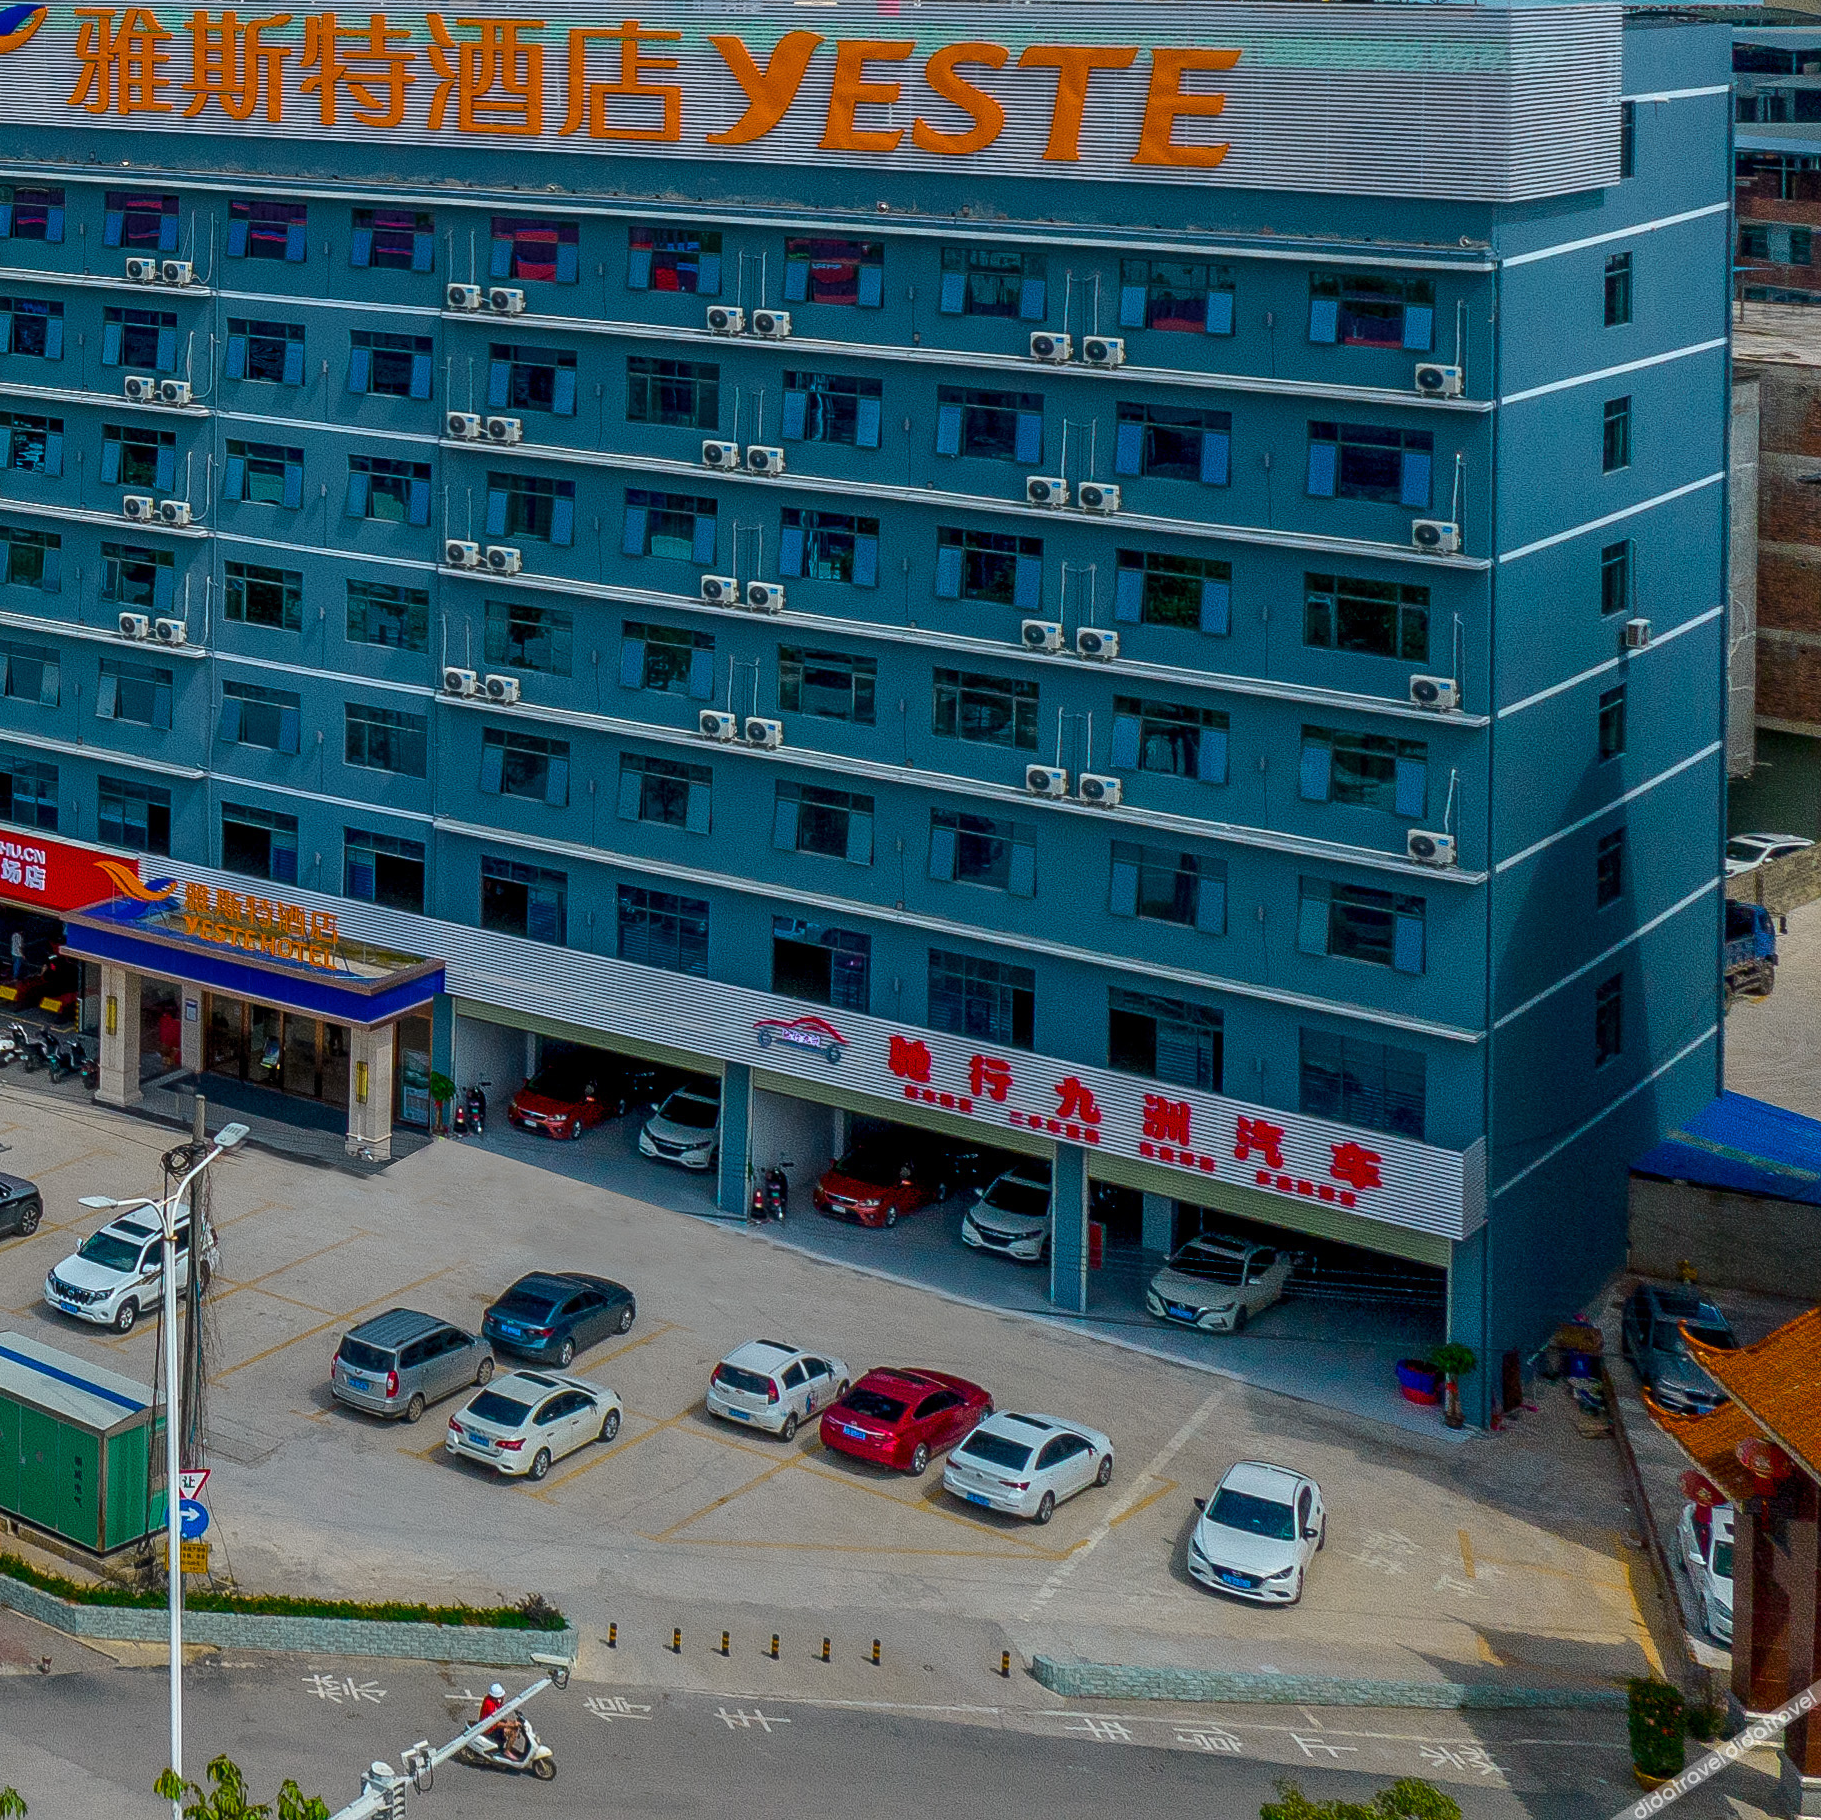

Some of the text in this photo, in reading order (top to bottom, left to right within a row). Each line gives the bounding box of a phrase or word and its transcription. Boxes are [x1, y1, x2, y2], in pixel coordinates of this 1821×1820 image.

[67, 6, 1242, 167] 雅斯特酒店 YESTE
[183, 914, 338, 970] YESTE HOTEL
[185, 881, 339, 944] 雅斯特酒店
[888, 1035, 1382, 1190] 驰行九洲汽车
[182, 1475, 196, 1489] 让
